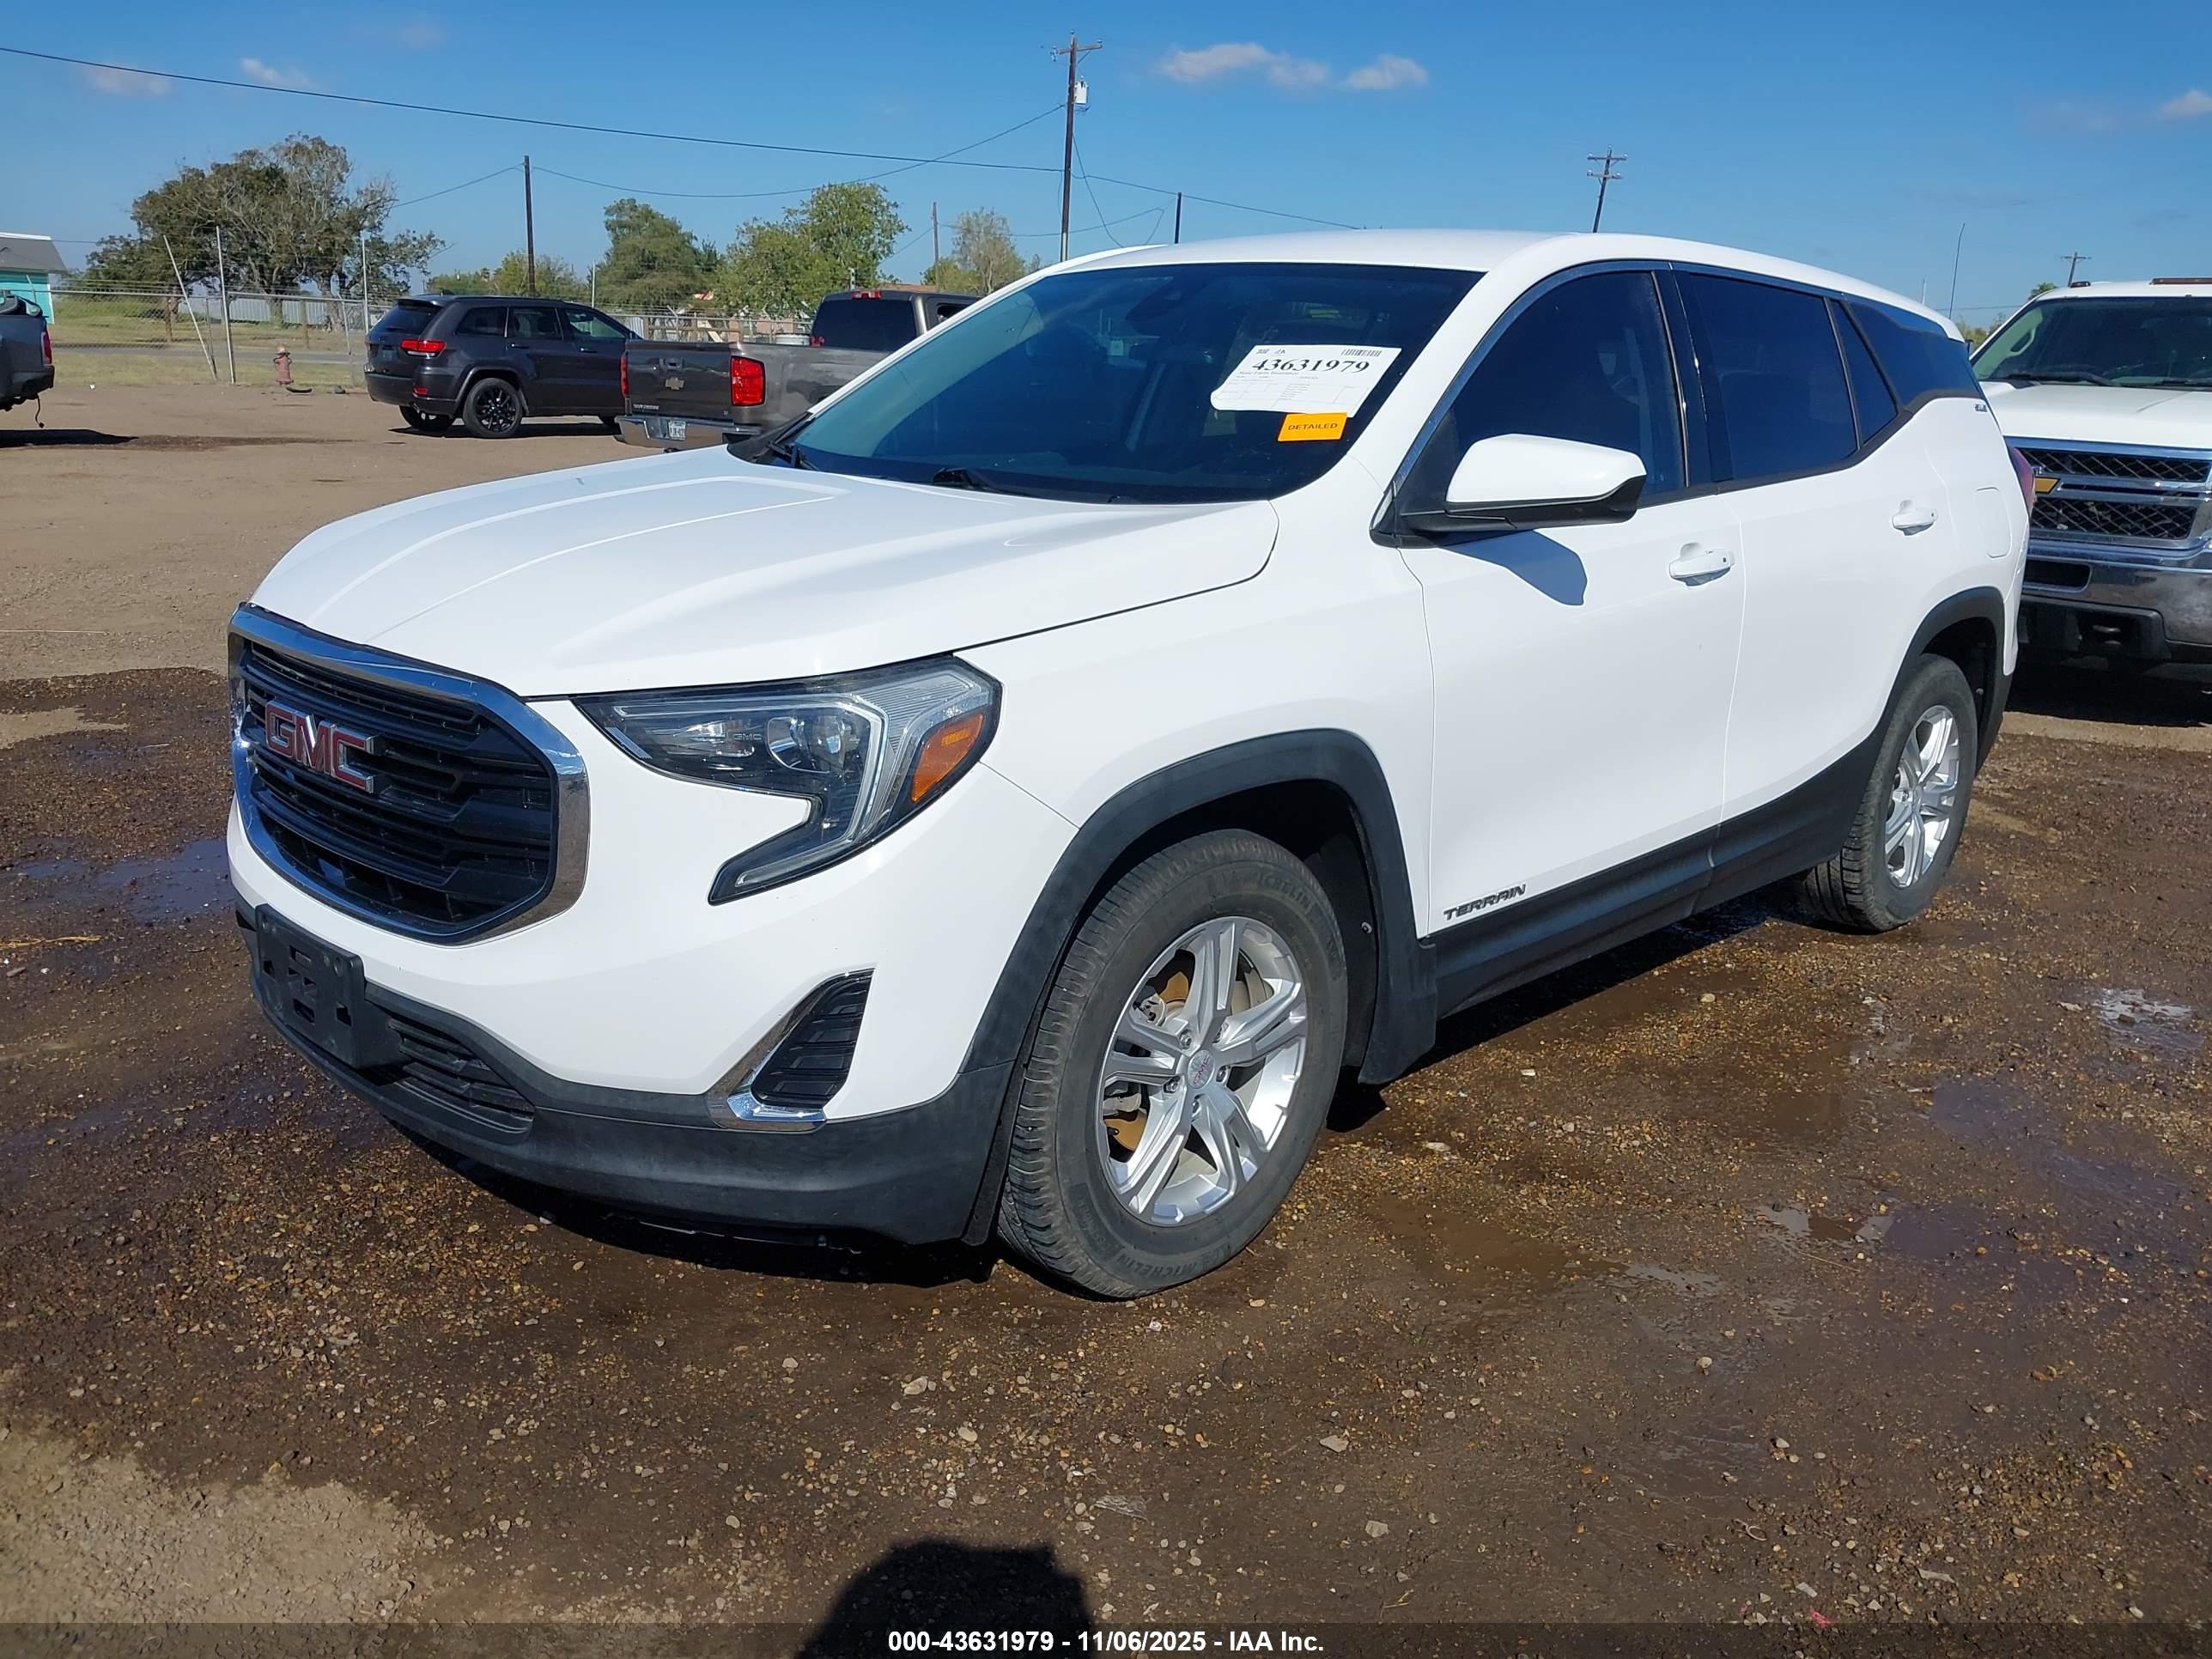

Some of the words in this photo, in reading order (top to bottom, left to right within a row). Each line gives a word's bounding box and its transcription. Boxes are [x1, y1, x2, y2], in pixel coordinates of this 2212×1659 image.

[1251, 358, 1371, 374] 43631979
[1287, 422, 1339, 431] DETAILED
[264, 700, 374, 793] GMC
[1253, 872, 1313, 910] ICHELIN
[1443, 883, 1527, 921] TERRAIN
[1115, 1254, 1198, 1279] MICHELIN
